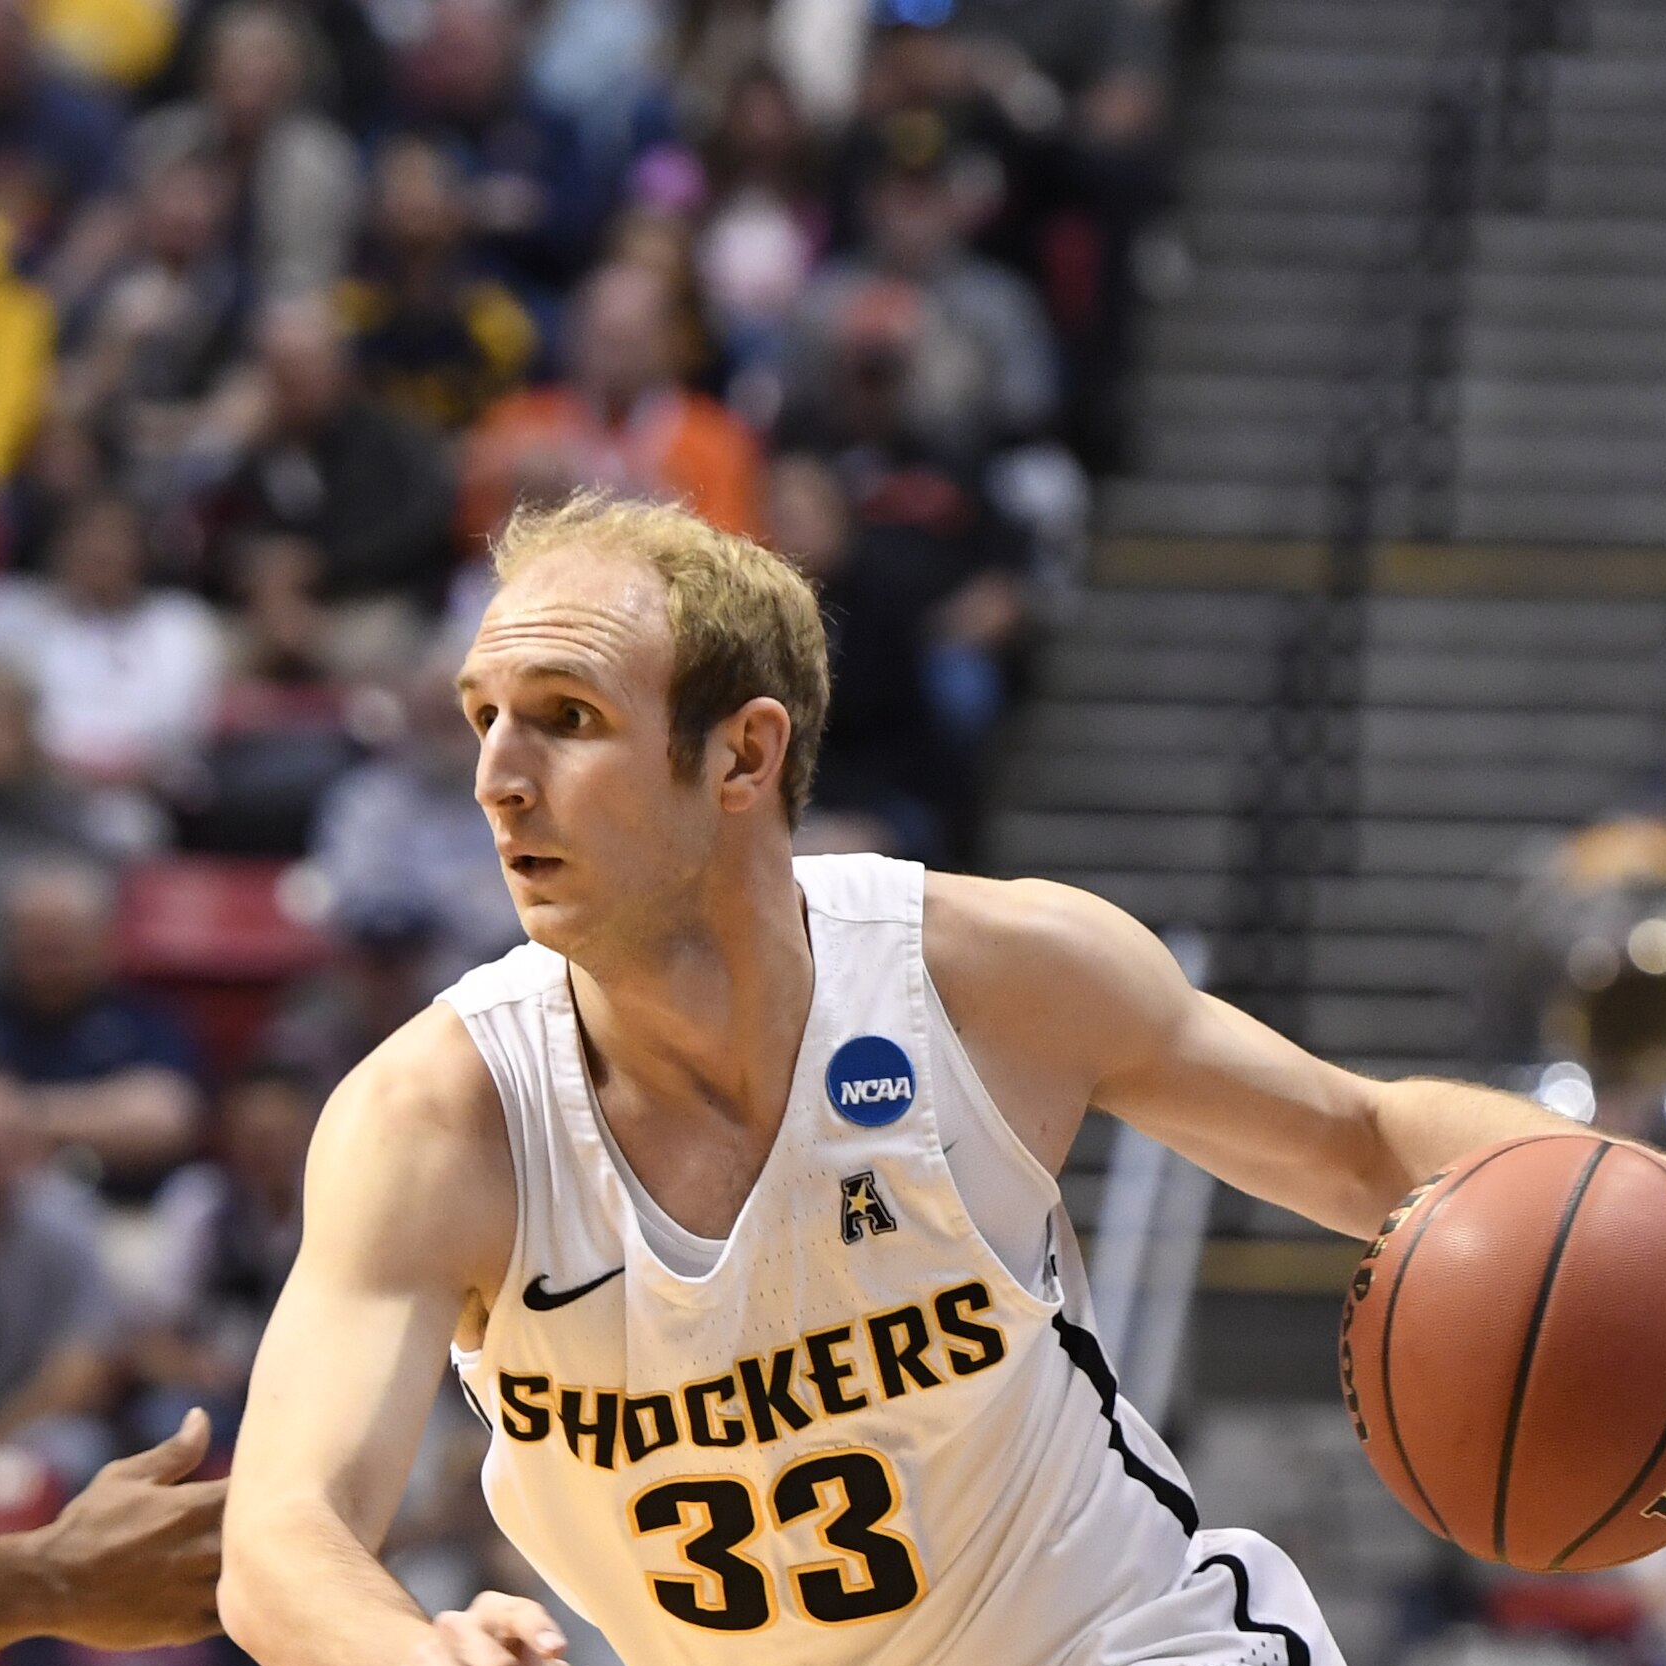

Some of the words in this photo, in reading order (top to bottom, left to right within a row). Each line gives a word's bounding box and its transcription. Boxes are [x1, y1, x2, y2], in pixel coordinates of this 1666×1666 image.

[841, 1076, 912, 1106] NCAA
[497, 1278, 1009, 1472] SHOCKERS
[625, 1446, 926, 1636] 33
